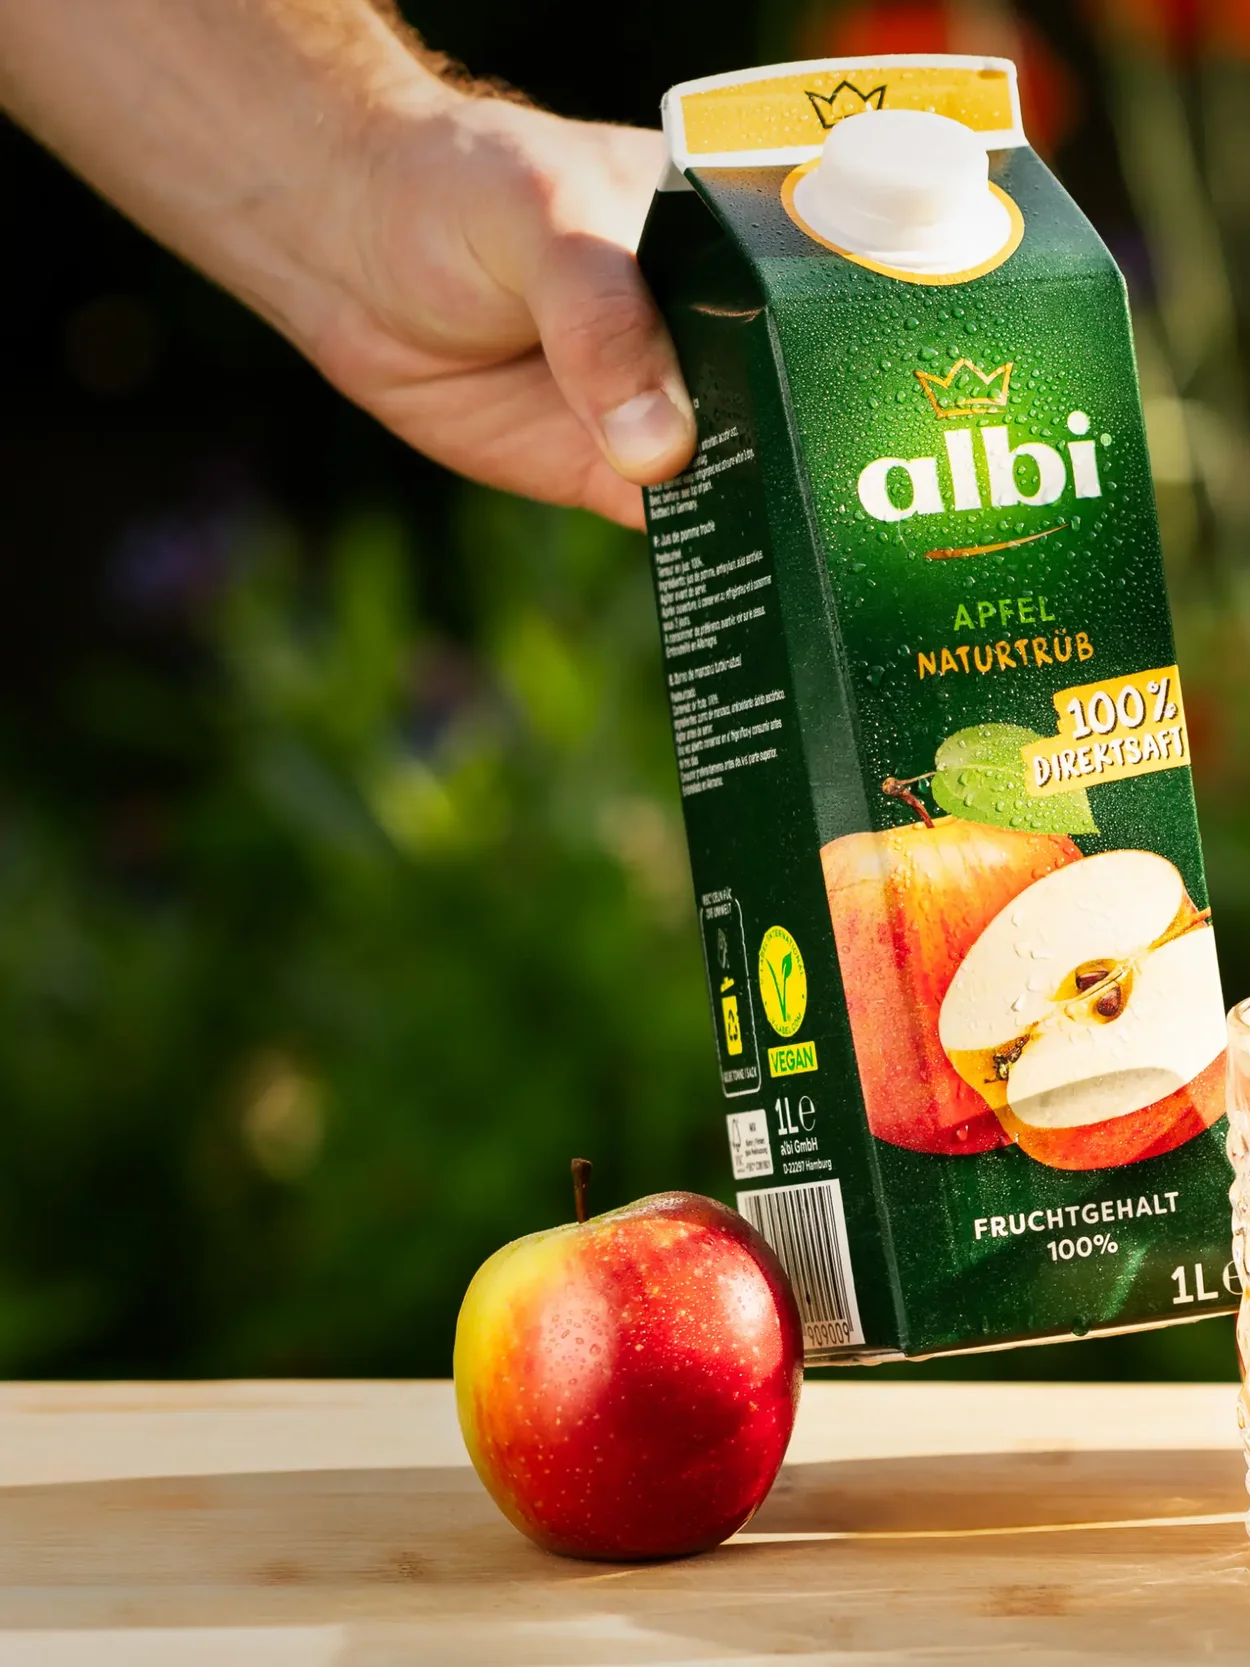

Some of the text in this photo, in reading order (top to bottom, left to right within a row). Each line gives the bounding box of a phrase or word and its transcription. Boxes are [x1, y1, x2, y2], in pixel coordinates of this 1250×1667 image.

[858, 410, 1102, 522] albi
[953, 596, 1055, 631] APFEL
[917, 629, 1095, 680] NATURTRÜB
[1067, 677, 1178, 740] 100%
[1032, 726, 1184, 788] DIREKTSAFT
[771, 1046, 815, 1074] VEGAN
[794, 1137, 818, 1154] GmbH
[805, 1158, 833, 1172] Hamburg
[974, 1191, 1180, 1240] FRUCHTGEHALT
[1047, 1233, 1119, 1262] 100%
